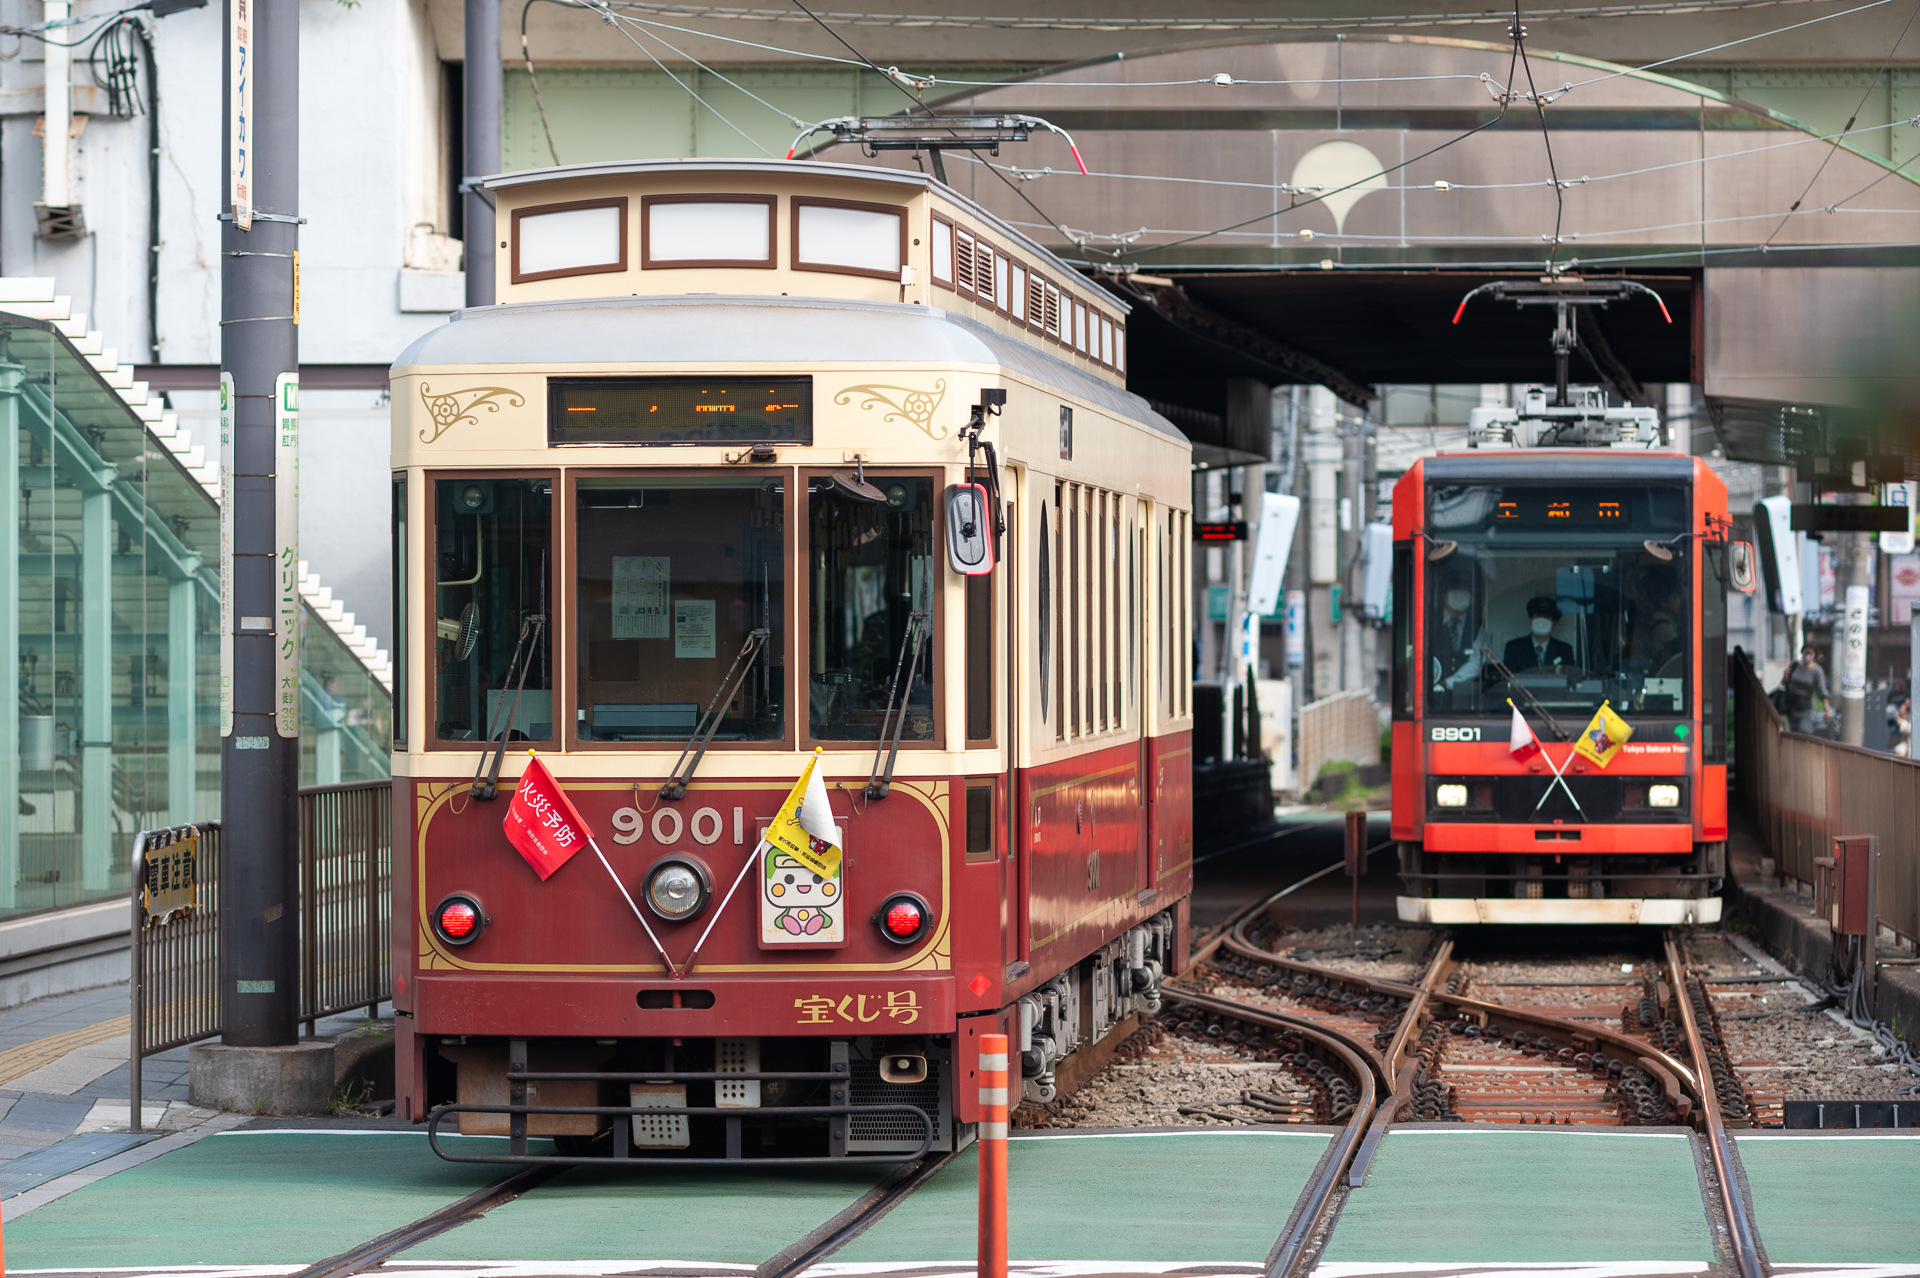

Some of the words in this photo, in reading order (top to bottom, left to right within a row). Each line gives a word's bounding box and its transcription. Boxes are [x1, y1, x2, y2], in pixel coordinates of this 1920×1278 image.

[238, 45, 246, 178] アイカワ
[281, 546, 295, 660] クリニック
[1431, 727, 1481, 742] 8901
[1622, 744, 1645, 755] Tokyo
[1645, 744, 1671, 753] Sakura
[519, 779, 576, 849] 火災予防
[611, 806, 744, 845] 9001
[793, 989, 923, 1025] 宝くじ号
